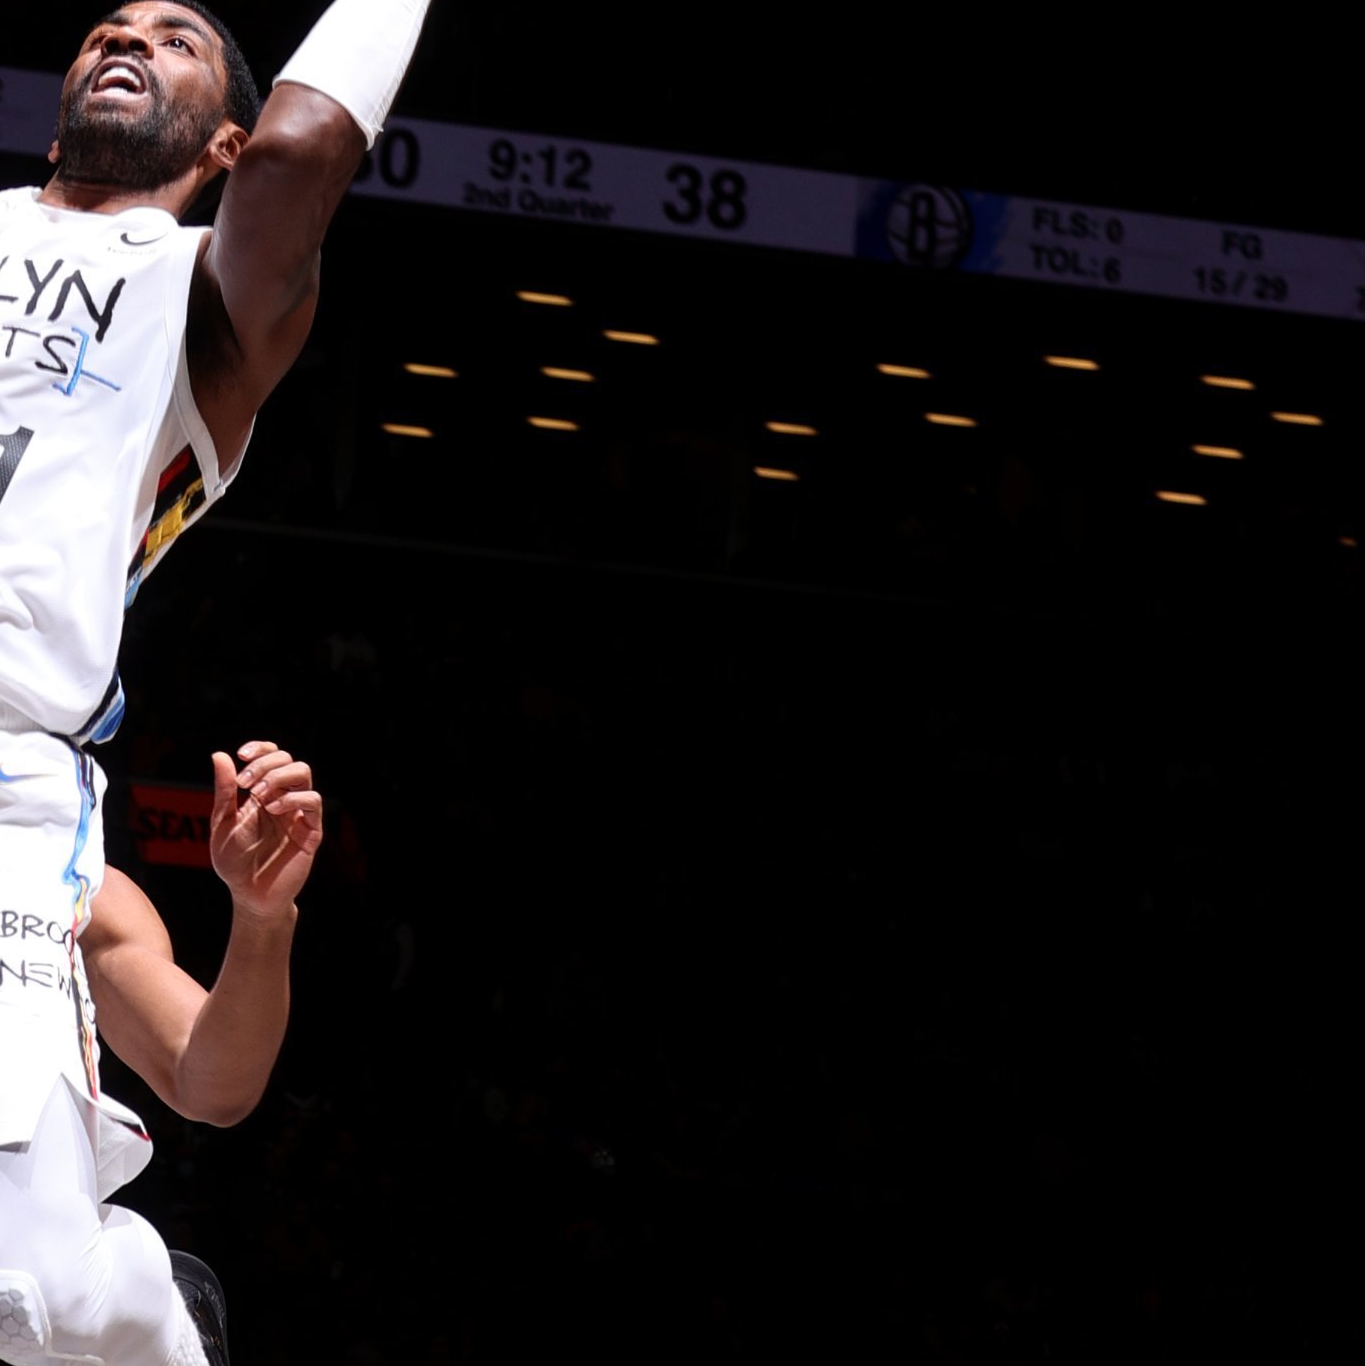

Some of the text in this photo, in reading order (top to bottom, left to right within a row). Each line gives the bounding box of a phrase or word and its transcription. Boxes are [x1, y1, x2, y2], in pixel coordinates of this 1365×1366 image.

[352, 129, 422, 189] 0
[489, 138, 593, 192] 9:12
[663, 164, 746, 230] 38
[1221, 231, 1263, 261] FG
